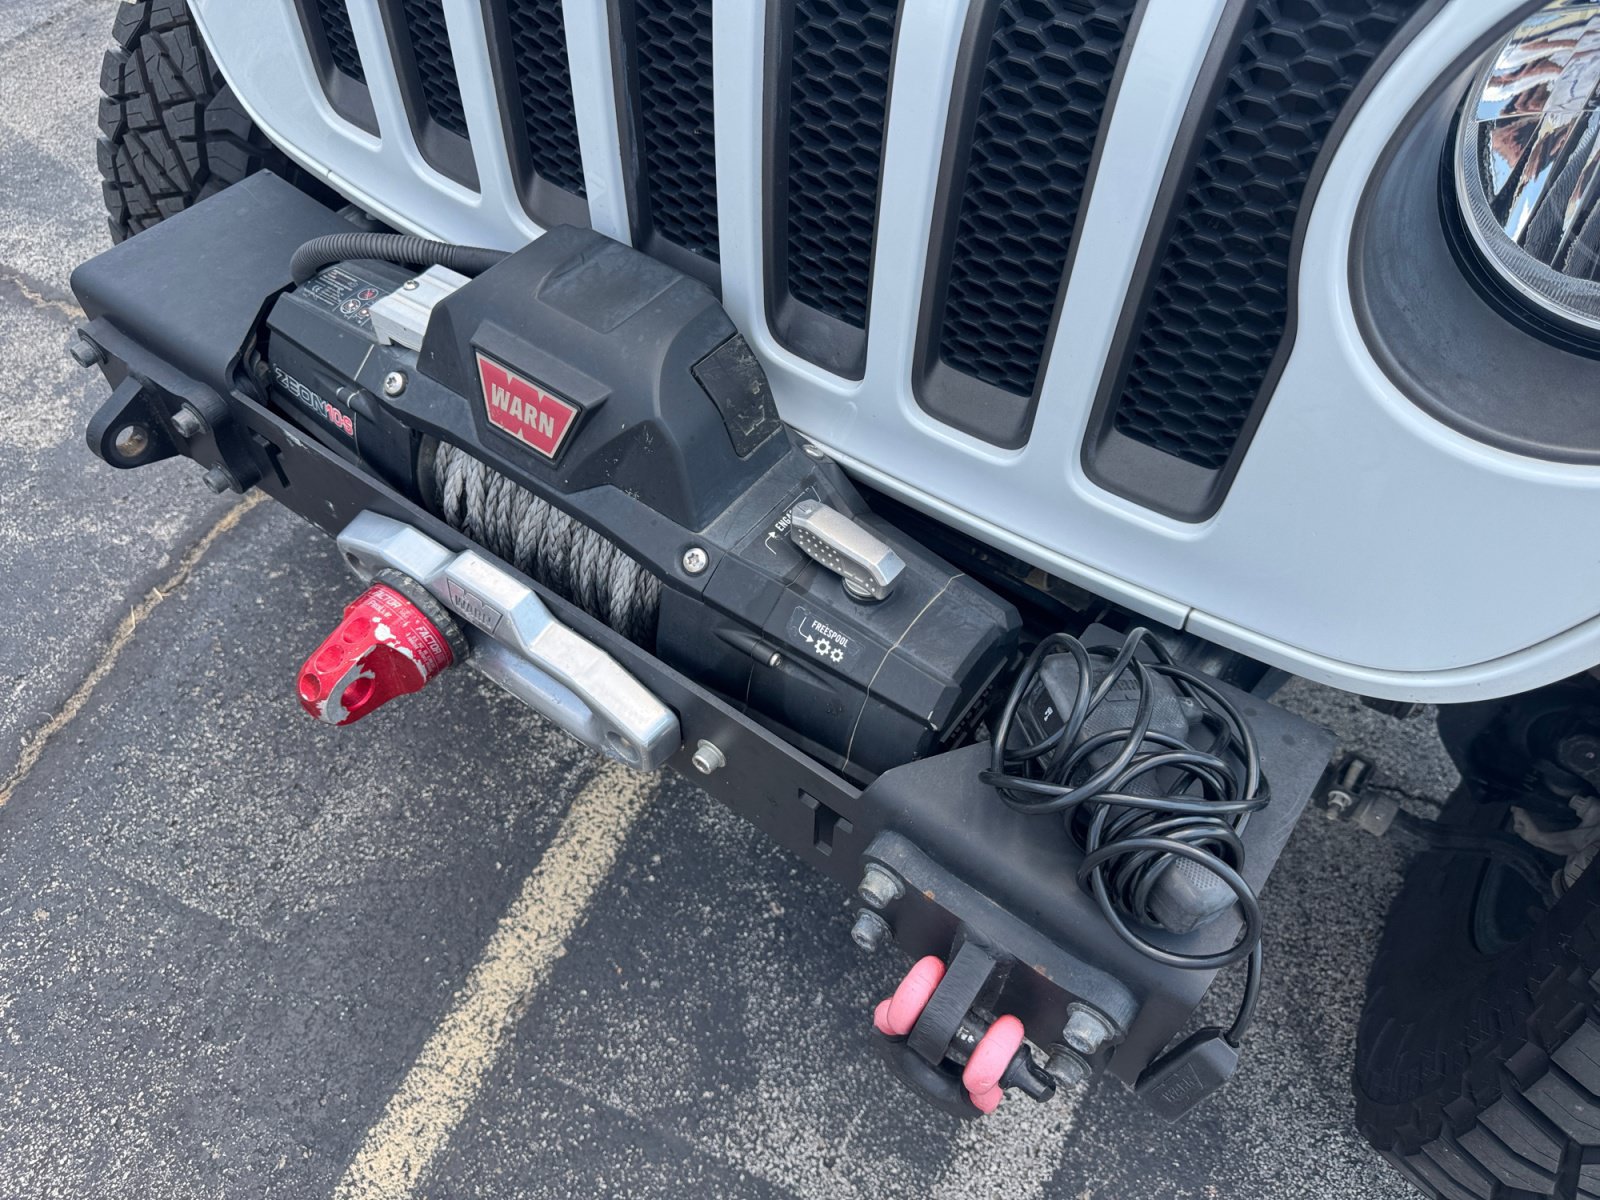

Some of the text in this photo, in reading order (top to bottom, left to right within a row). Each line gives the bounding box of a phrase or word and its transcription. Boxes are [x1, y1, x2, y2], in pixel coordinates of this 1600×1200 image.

[492, 383, 554, 438] WARN
[455, 594, 492, 626] WARN
[416, 625, 443, 655] FACTOR
[811, 620, 848, 648] FREESPOOL
